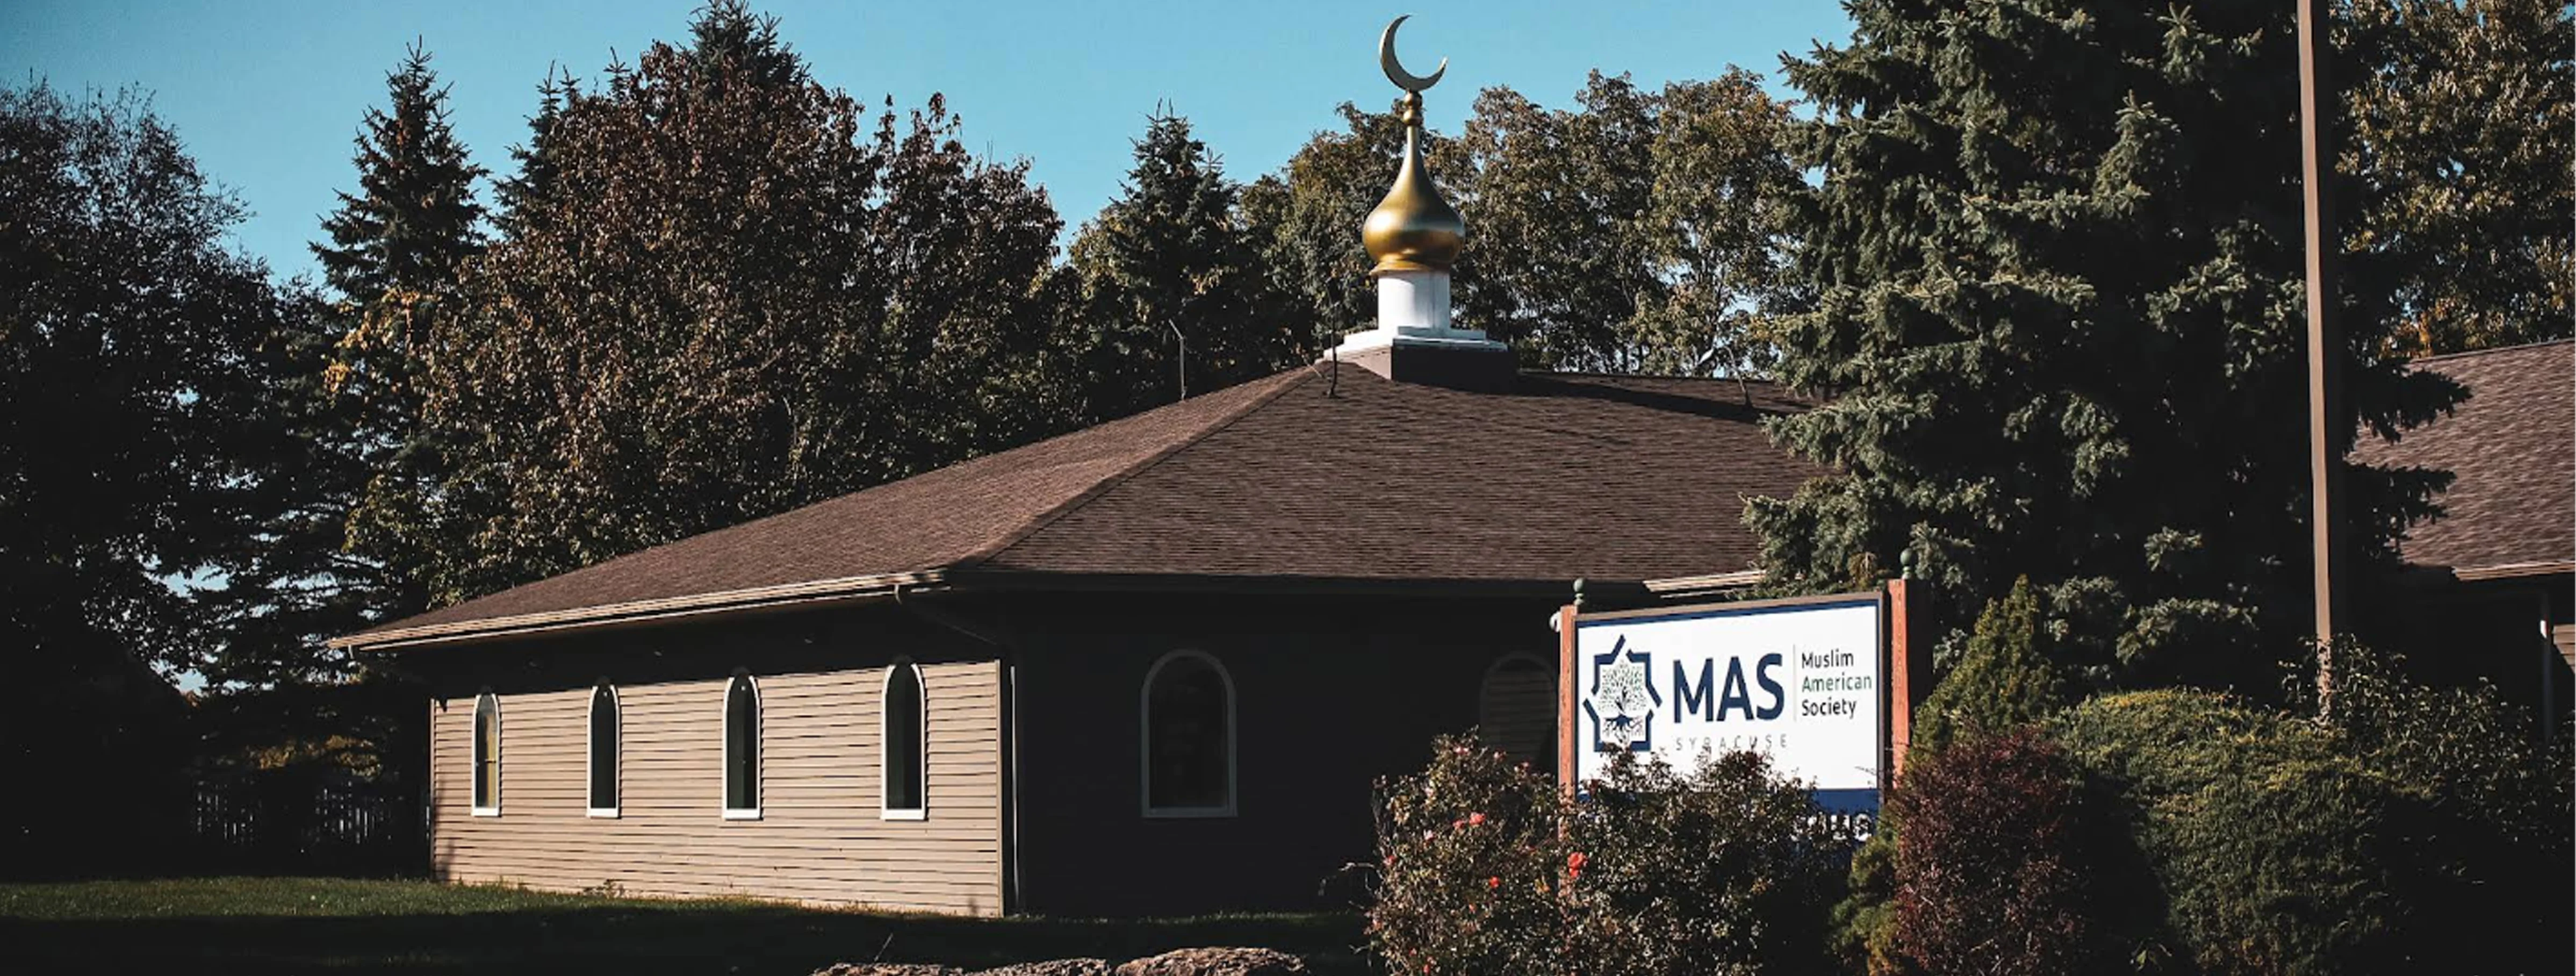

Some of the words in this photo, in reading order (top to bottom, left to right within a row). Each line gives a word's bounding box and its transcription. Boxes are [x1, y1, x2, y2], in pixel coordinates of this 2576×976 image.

[1801, 648, 1854, 669] Muslim
[1674, 654, 1784, 723] MAS
[1801, 671, 1872, 693] American
[1801, 696, 1857, 720] Society
